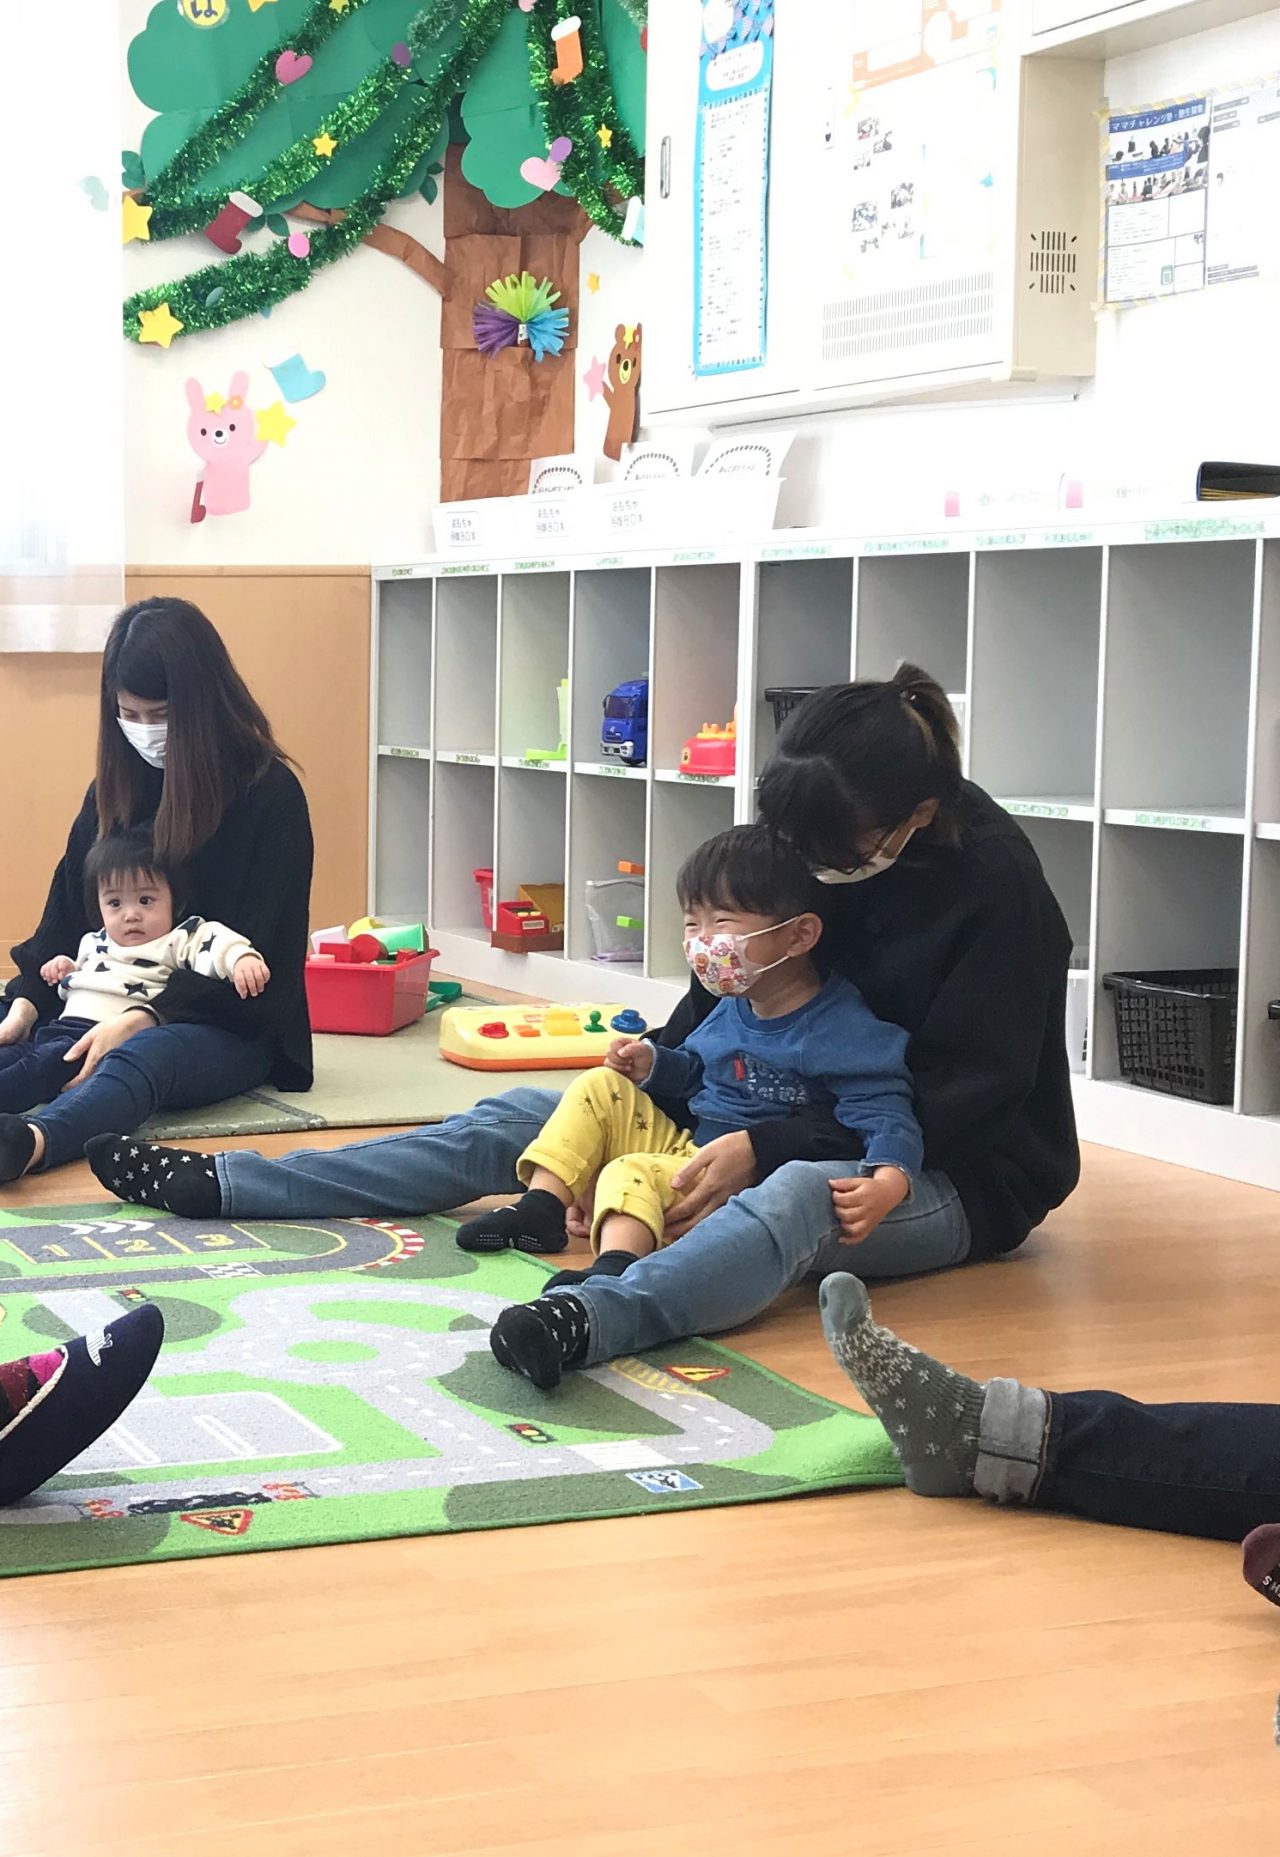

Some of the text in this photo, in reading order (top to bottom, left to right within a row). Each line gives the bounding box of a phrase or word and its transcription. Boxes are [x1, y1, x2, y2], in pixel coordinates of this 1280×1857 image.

[115, 1238, 156, 1253] 2
[195, 1233, 235, 1247] 3
[41, 1243, 71, 1257] 1
[1262, 1575, 1280, 1598] SH
